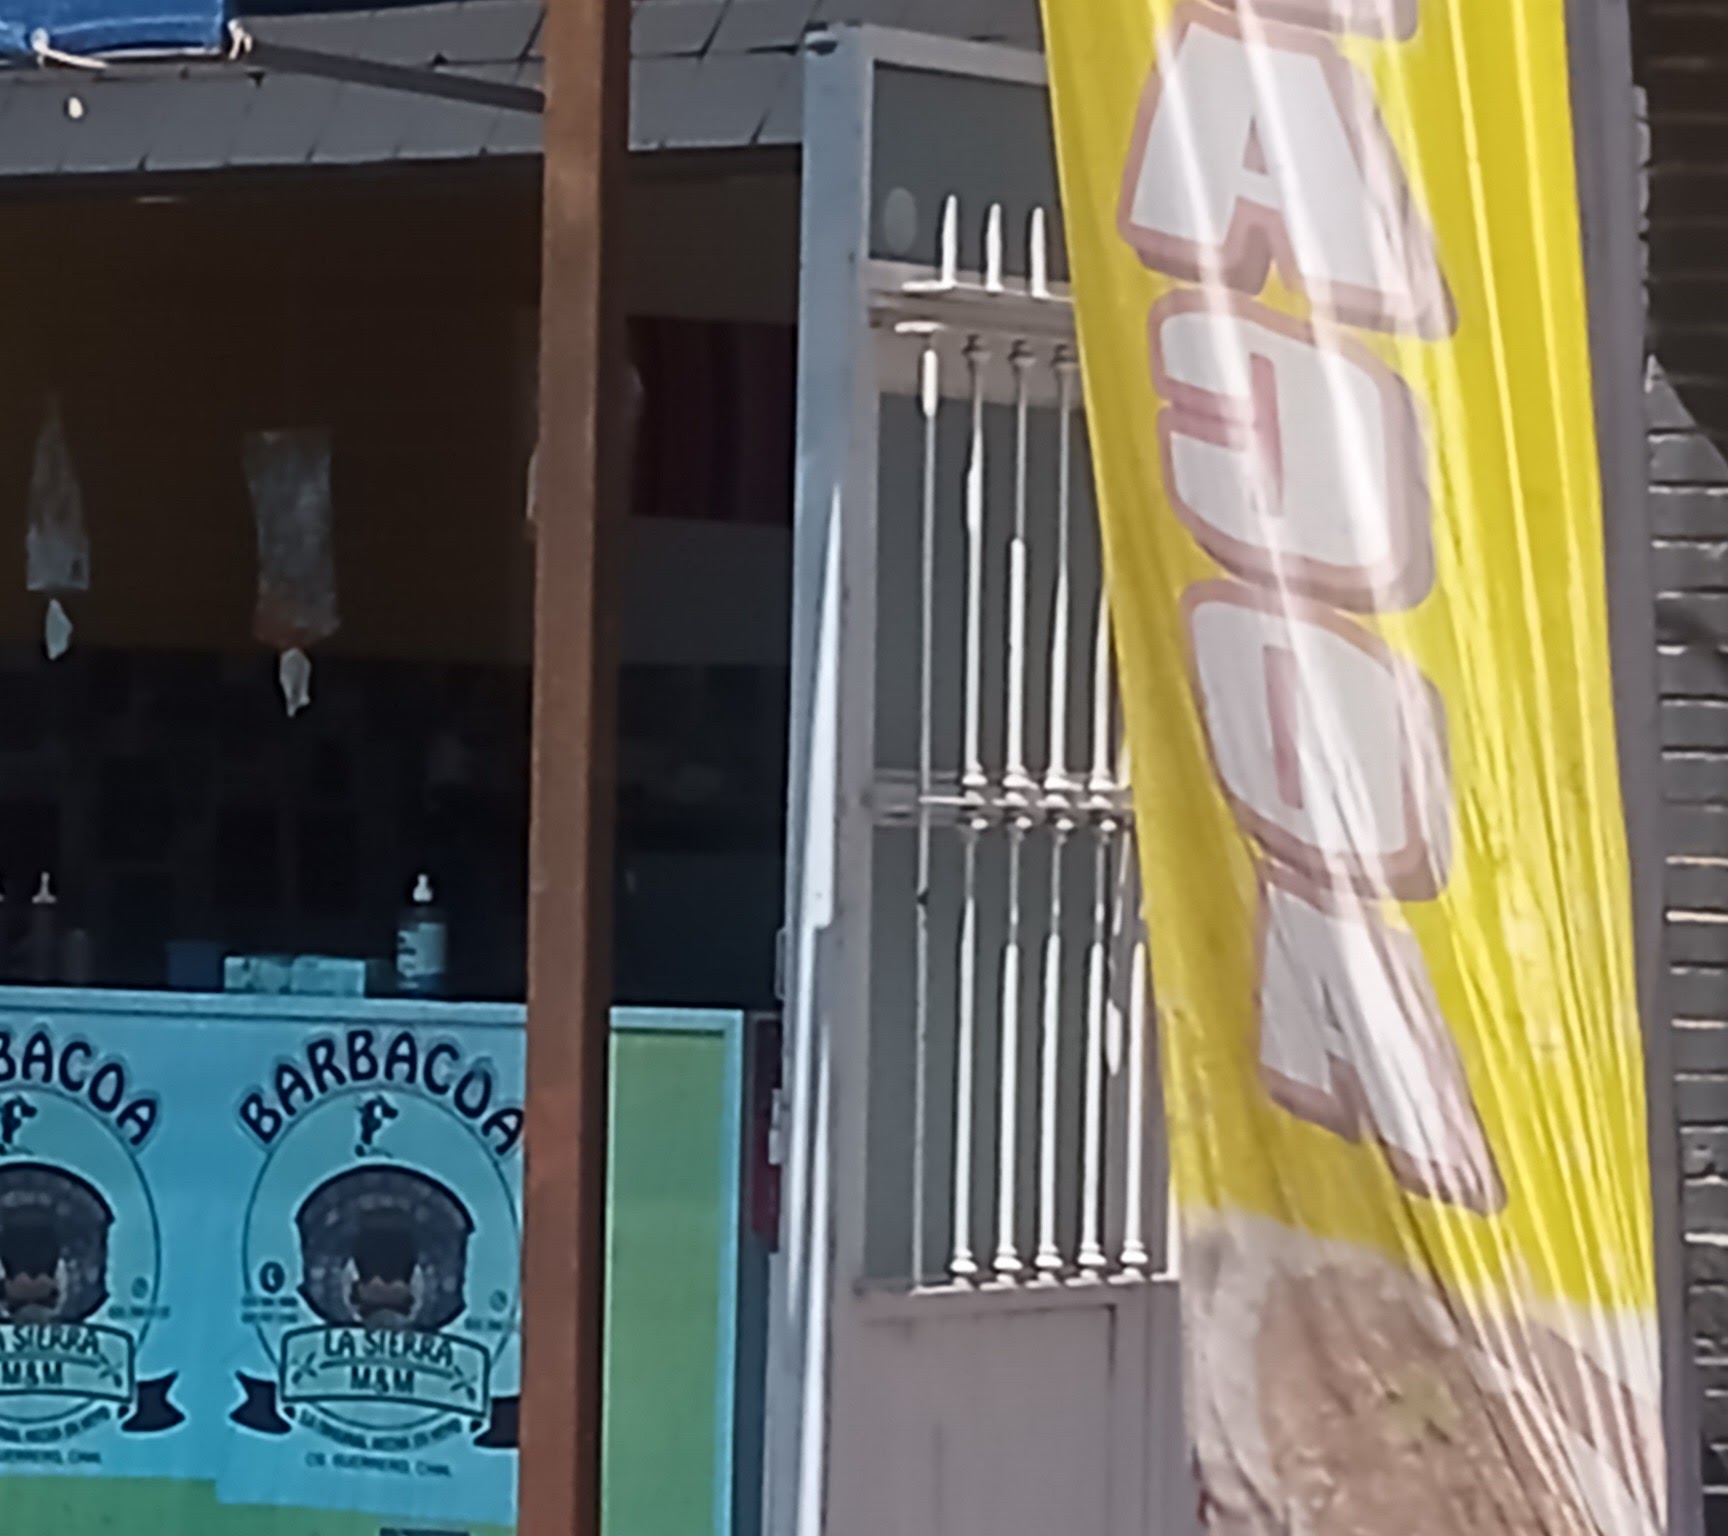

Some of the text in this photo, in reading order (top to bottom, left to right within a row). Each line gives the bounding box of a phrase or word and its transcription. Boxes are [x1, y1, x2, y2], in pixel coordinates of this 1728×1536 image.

[241, 1029, 524, 1156] BARBACOA
[324, 1329, 454, 1367] LA SIERRA
